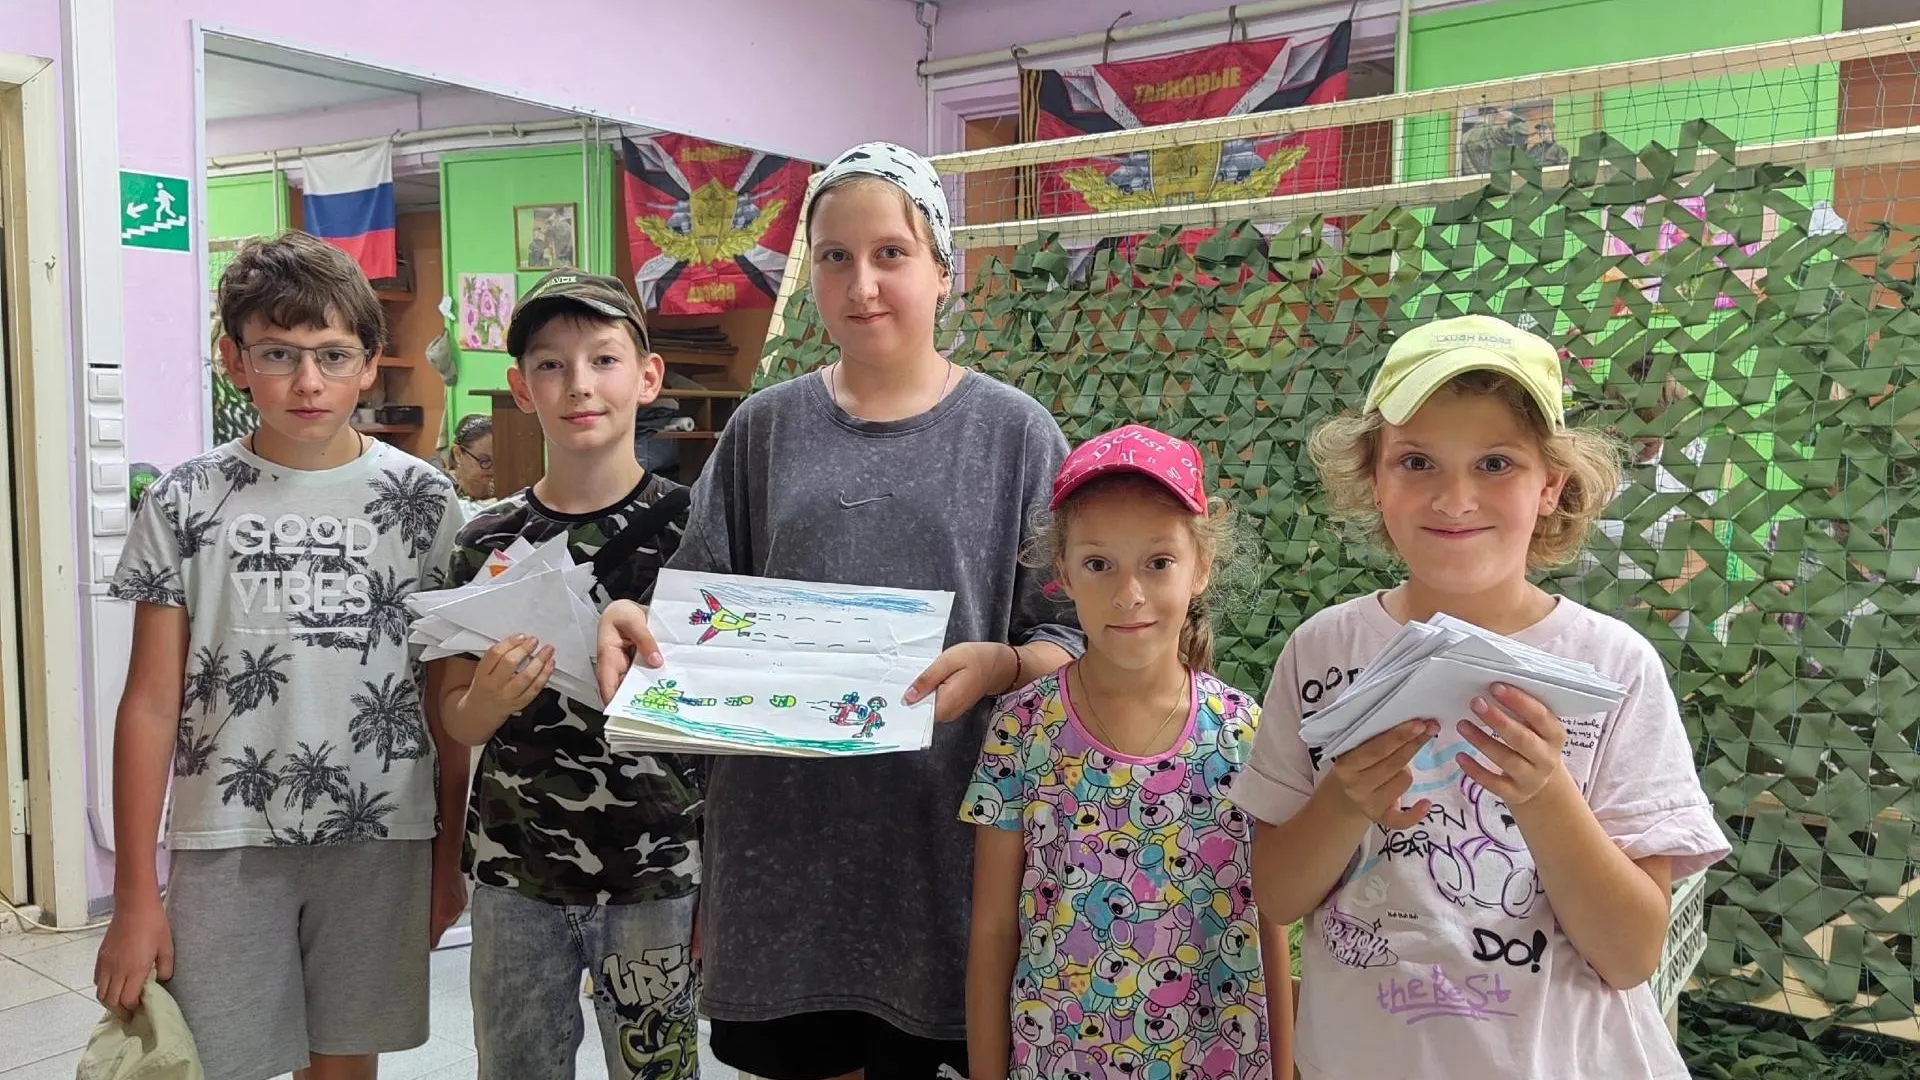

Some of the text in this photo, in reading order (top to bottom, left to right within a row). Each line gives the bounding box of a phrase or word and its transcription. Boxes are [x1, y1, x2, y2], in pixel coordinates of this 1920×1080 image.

[1436, 334, 1476, 343] LAUGH
[228, 513, 379, 557] GOOD
[230, 570, 372, 615] VIBES
[1472, 927, 1548, 974] DO!
